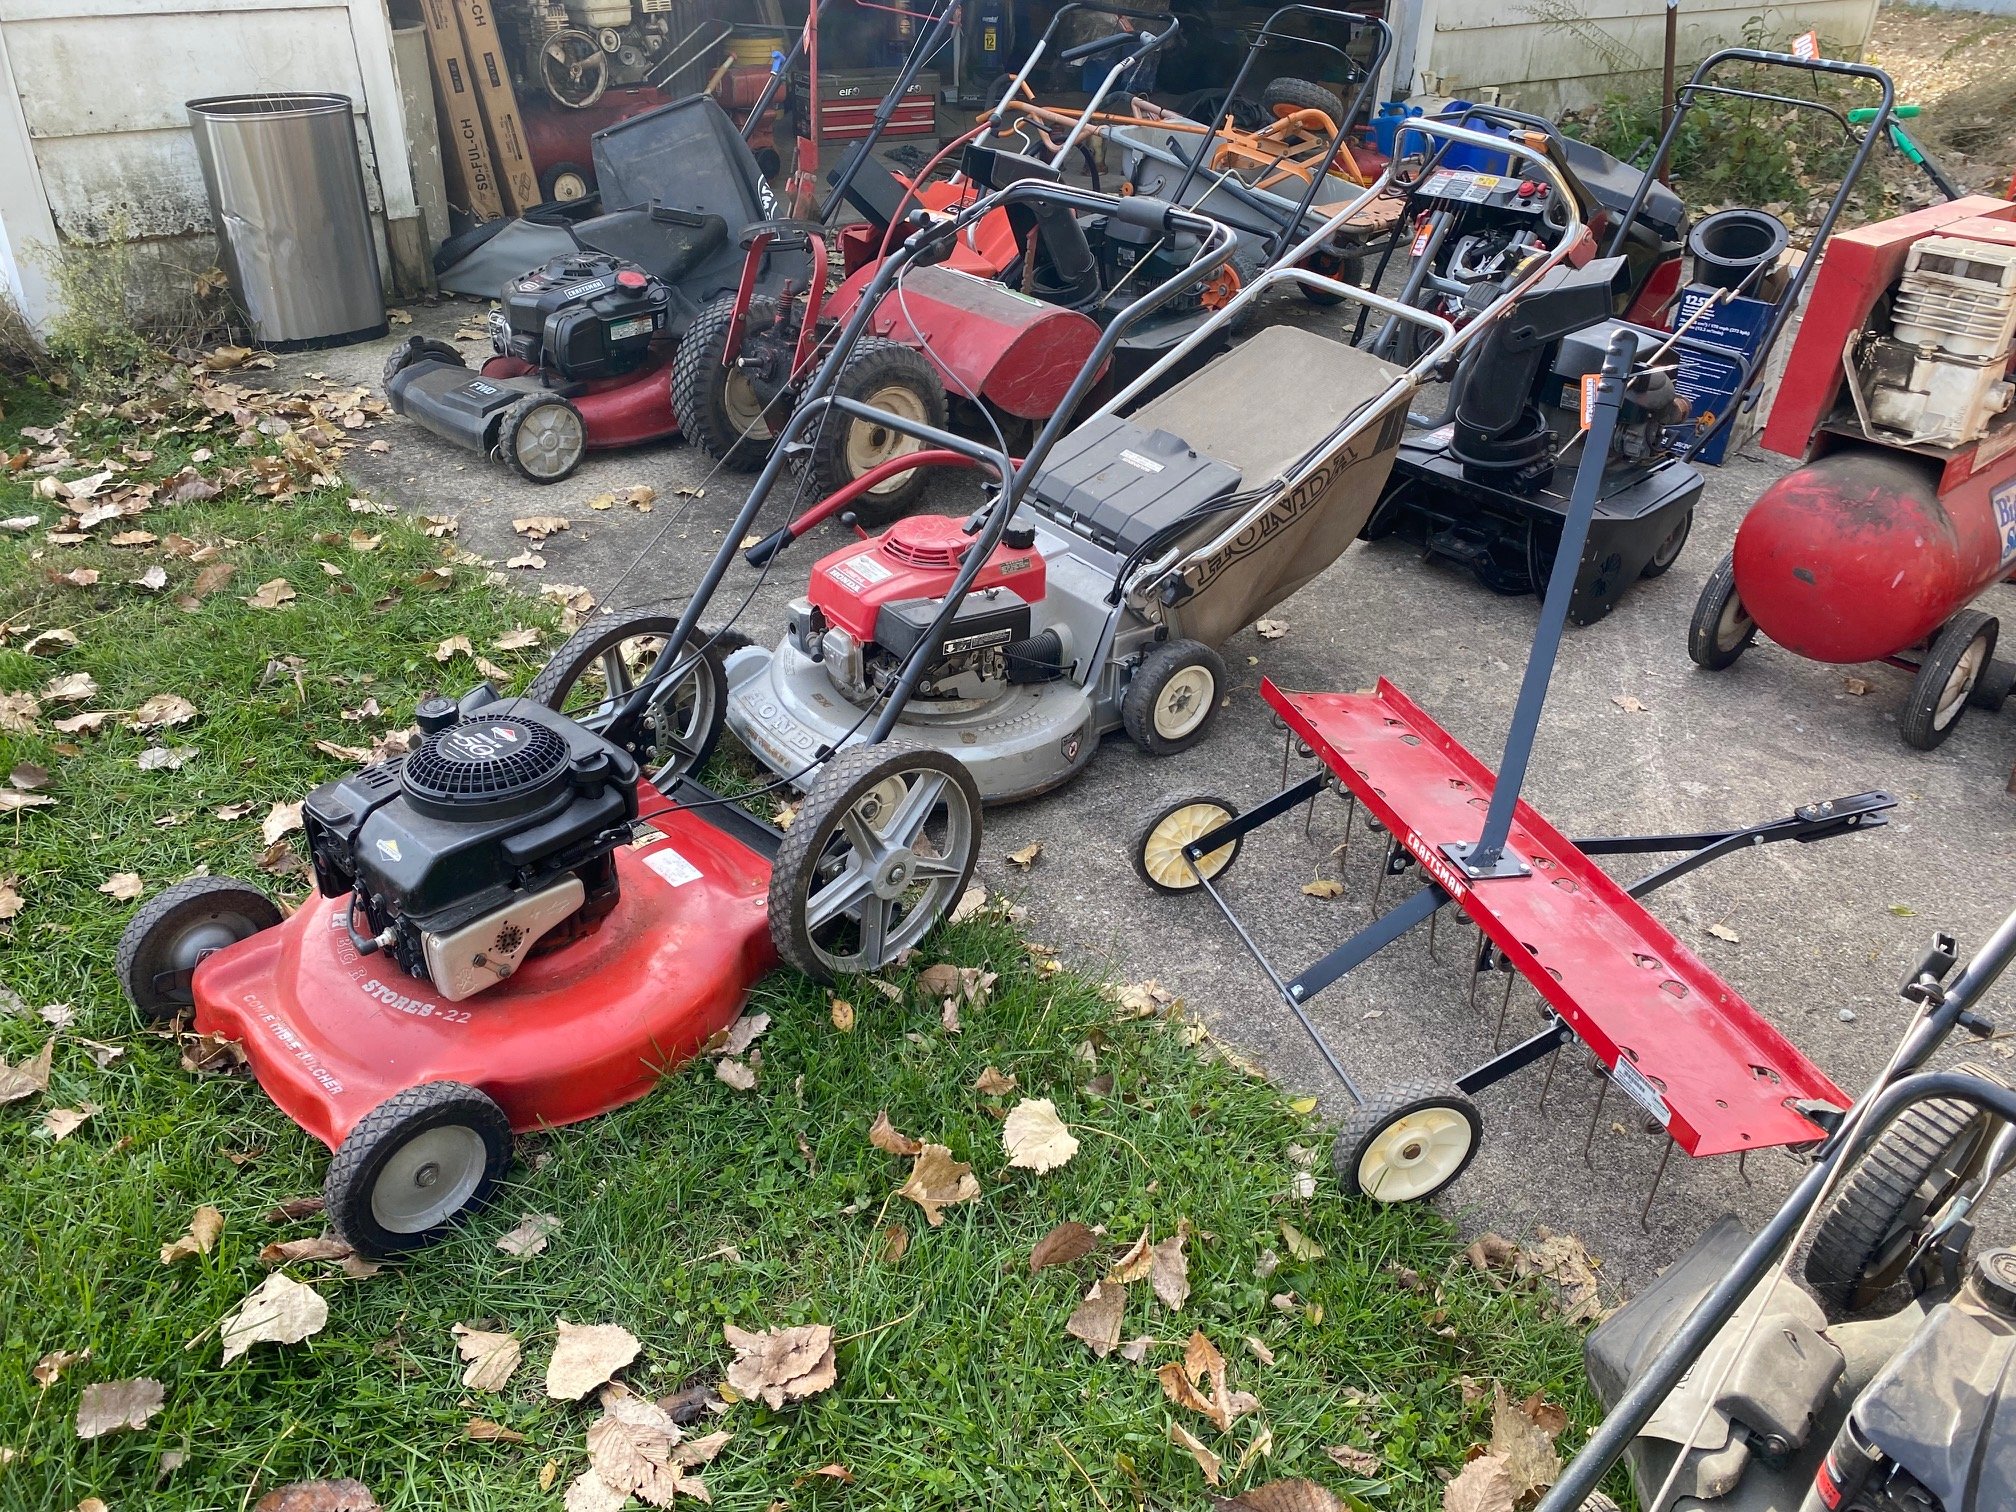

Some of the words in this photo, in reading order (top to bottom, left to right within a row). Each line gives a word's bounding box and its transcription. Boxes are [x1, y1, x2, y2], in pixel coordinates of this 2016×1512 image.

[461, 118, 488, 191] SD-FUL-CH
[567, 281, 602, 298] CRAFTSMAN
[469, 381, 497, 395] FWD
[1198, 447, 1359, 586] HONDA
[829, 568, 861, 593] HONDA
[742, 690, 816, 759] HOND
[1408, 832, 1463, 898] CRAFTSMAN
